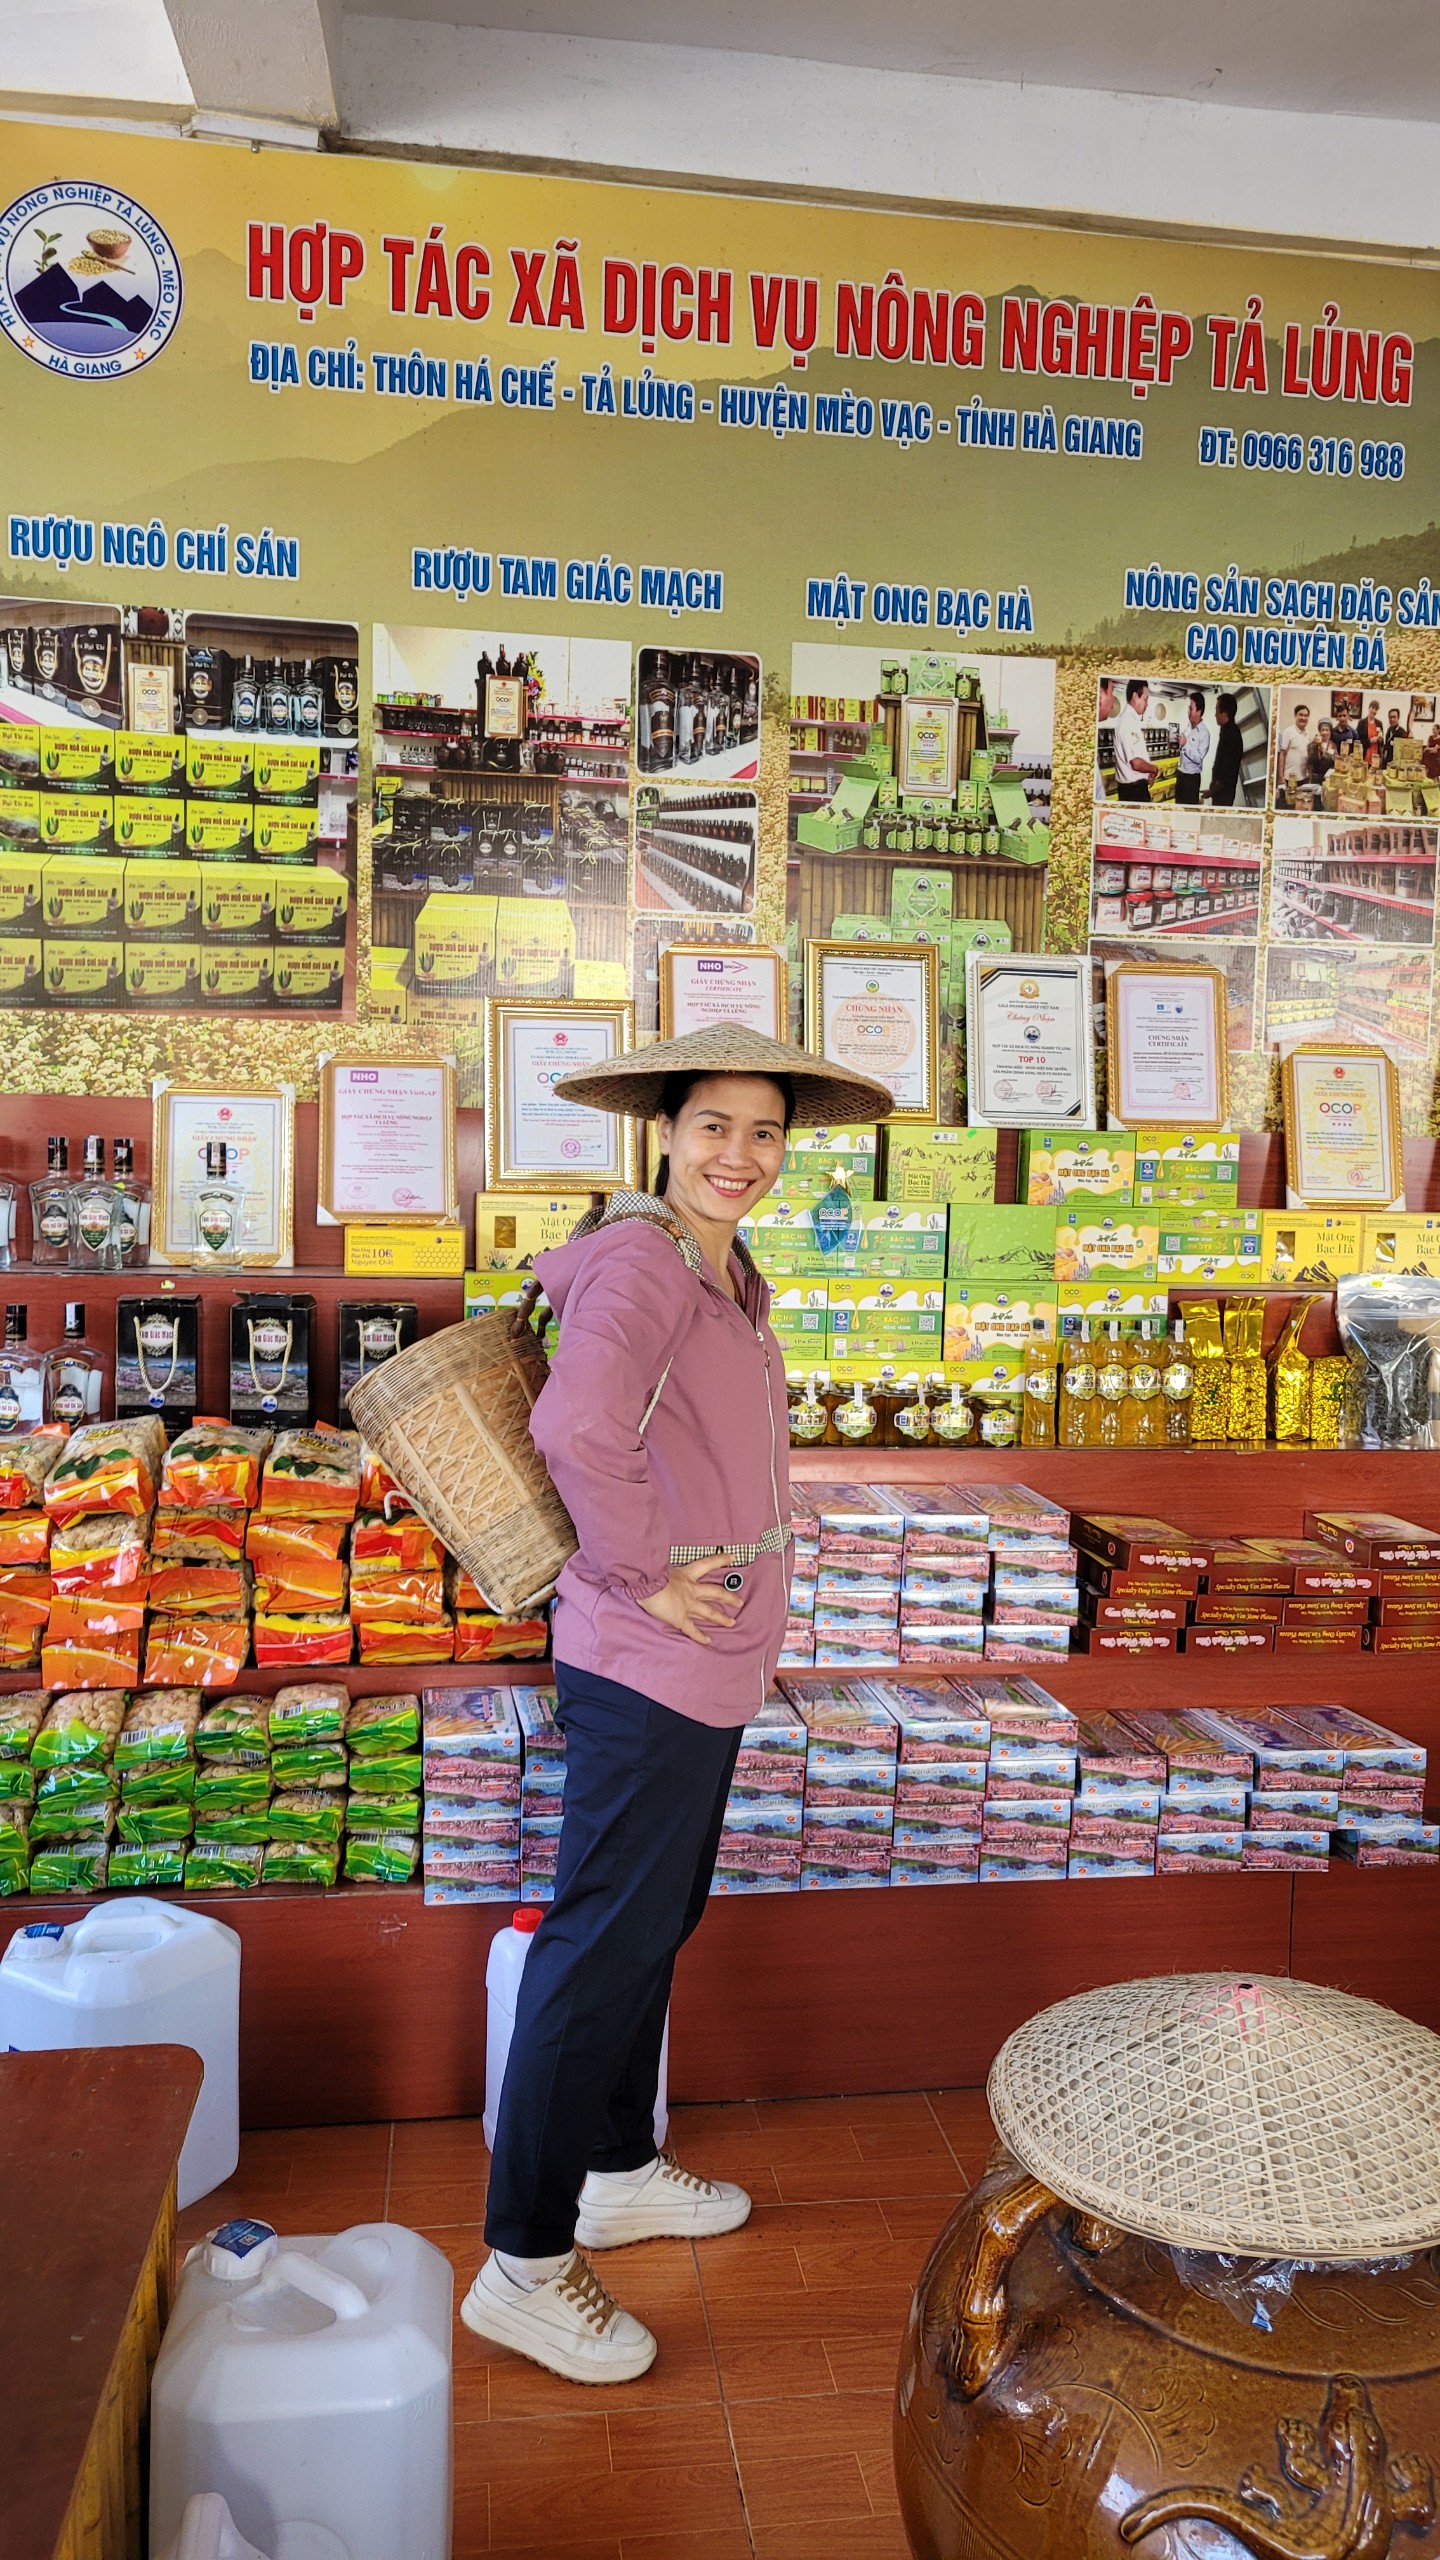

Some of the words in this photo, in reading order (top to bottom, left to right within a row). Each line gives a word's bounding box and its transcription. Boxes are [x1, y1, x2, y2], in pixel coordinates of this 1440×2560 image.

[161, 270, 177, 304] MÈO
[249, 222, 363, 320] HỢP
[384, 226, 490, 320] TÁC
[511, 241, 585, 331] XÃ
[605, 260, 732, 353] DỊCH
[751, 274, 818, 368] VỤ
[836, 272, 984, 368] NÔNG
[1001, 296, 1191, 398] NGHIỆP
[1208, 297, 1268, 393] TẢ
[1284, 304, 1413, 405] LỦNG
[48, 355, 68, 371] HÀ
[74, 360, 122, 374] GIANG
[251, 343, 298, 391] ĐỊA
[309, 340, 365, 389] CHỈ:
[374, 353, 444, 396] THÔN
[455, 357, 492, 402] HÁ
[501, 362, 555, 407] CHẾ
[562, 390, 574, 400] -
[582, 368, 614, 413] TẢ
[623, 369, 692, 420] LỦNG
[702, 403, 712, 411] -
[720, 386, 806, 438] HUYỆN
[816, 392, 872, 436] MÈO
[882, 401, 931, 447] VẠC
[939, 423, 949, 432] -
[957, 397, 1015, 448] TỈNH
[1024, 407, 1056, 452] HÀ
[1064, 417, 1141, 459] GIANG
[1200, 428, 1236, 467] ĐT:
[1243, 432, 1301, 473] 0966
[1309, 437, 1353, 475] 316
[1360, 441, 1404, 479] 988
[10, 516, 93, 569] RƯỢU
[103, 519, 166, 567] NGÔ
[177, 526, 227, 573] CHÍ
[236, 527, 298, 579] SÁN
[412, 547, 490, 600] RƯỢU
[499, 556, 557, 598] TAM
[566, 556, 631, 604] GIÁC
[640, 566, 723, 616] MẠCH
[1125, 563, 1198, 611] NÔNG
[1205, 566, 1258, 616] SẢN
[1266, 578, 1334, 630] SẠCH
[1341, 578, 1391, 629] ĐẶC
[1398, 578, 1440, 627] SẢN
[807, 572, 865, 627] MẬT
[874, 584, 928, 625] ONG
[937, 590, 988, 636] BẠC
[998, 587, 1032, 632] HÀ
[1187, 625, 1236, 664] CAO
[1243, 625, 1345, 670] NGUYÊN
[1352, 630, 1386, 672] ĐÁ
[700, 962, 721, 971] NHO
[857, 1025, 890, 1035] OCOP
[1018, 1055, 1034, 1063] TOP
[1036, 1056, 1046, 1064] 10
[352, 1072, 377, 1081] NHO
[1319, 1102, 1362, 1115] OCOP
[198, 1148, 250, 1161] OOP
[541, 1217, 559, 1227] Mật
[562, 1217, 576, 1226] On
[541, 1228, 562, 1242] Bạc
[1317, 1233, 1333, 1241] Mật
[1337, 1233, 1355, 1243] Ong
[1417, 1233, 1434, 1243] Mật
[1317, 1243, 1334, 1255] Bạc
[1338, 1244, 1353, 1253] Hà
[1417, 1245, 1434, 1256] Bạc
[990, 1323, 1004, 1331] ONG
[254, 1335, 262, 1343] am
[263, 1333, 273, 1343] Giác
[372, 1333, 382, 1342] Giác
[1115, 1587, 1137, 1595] Specialty
[1215, 1583, 1236, 1591] Specialty
[1201, 1612, 1222, 1620] Specialty
